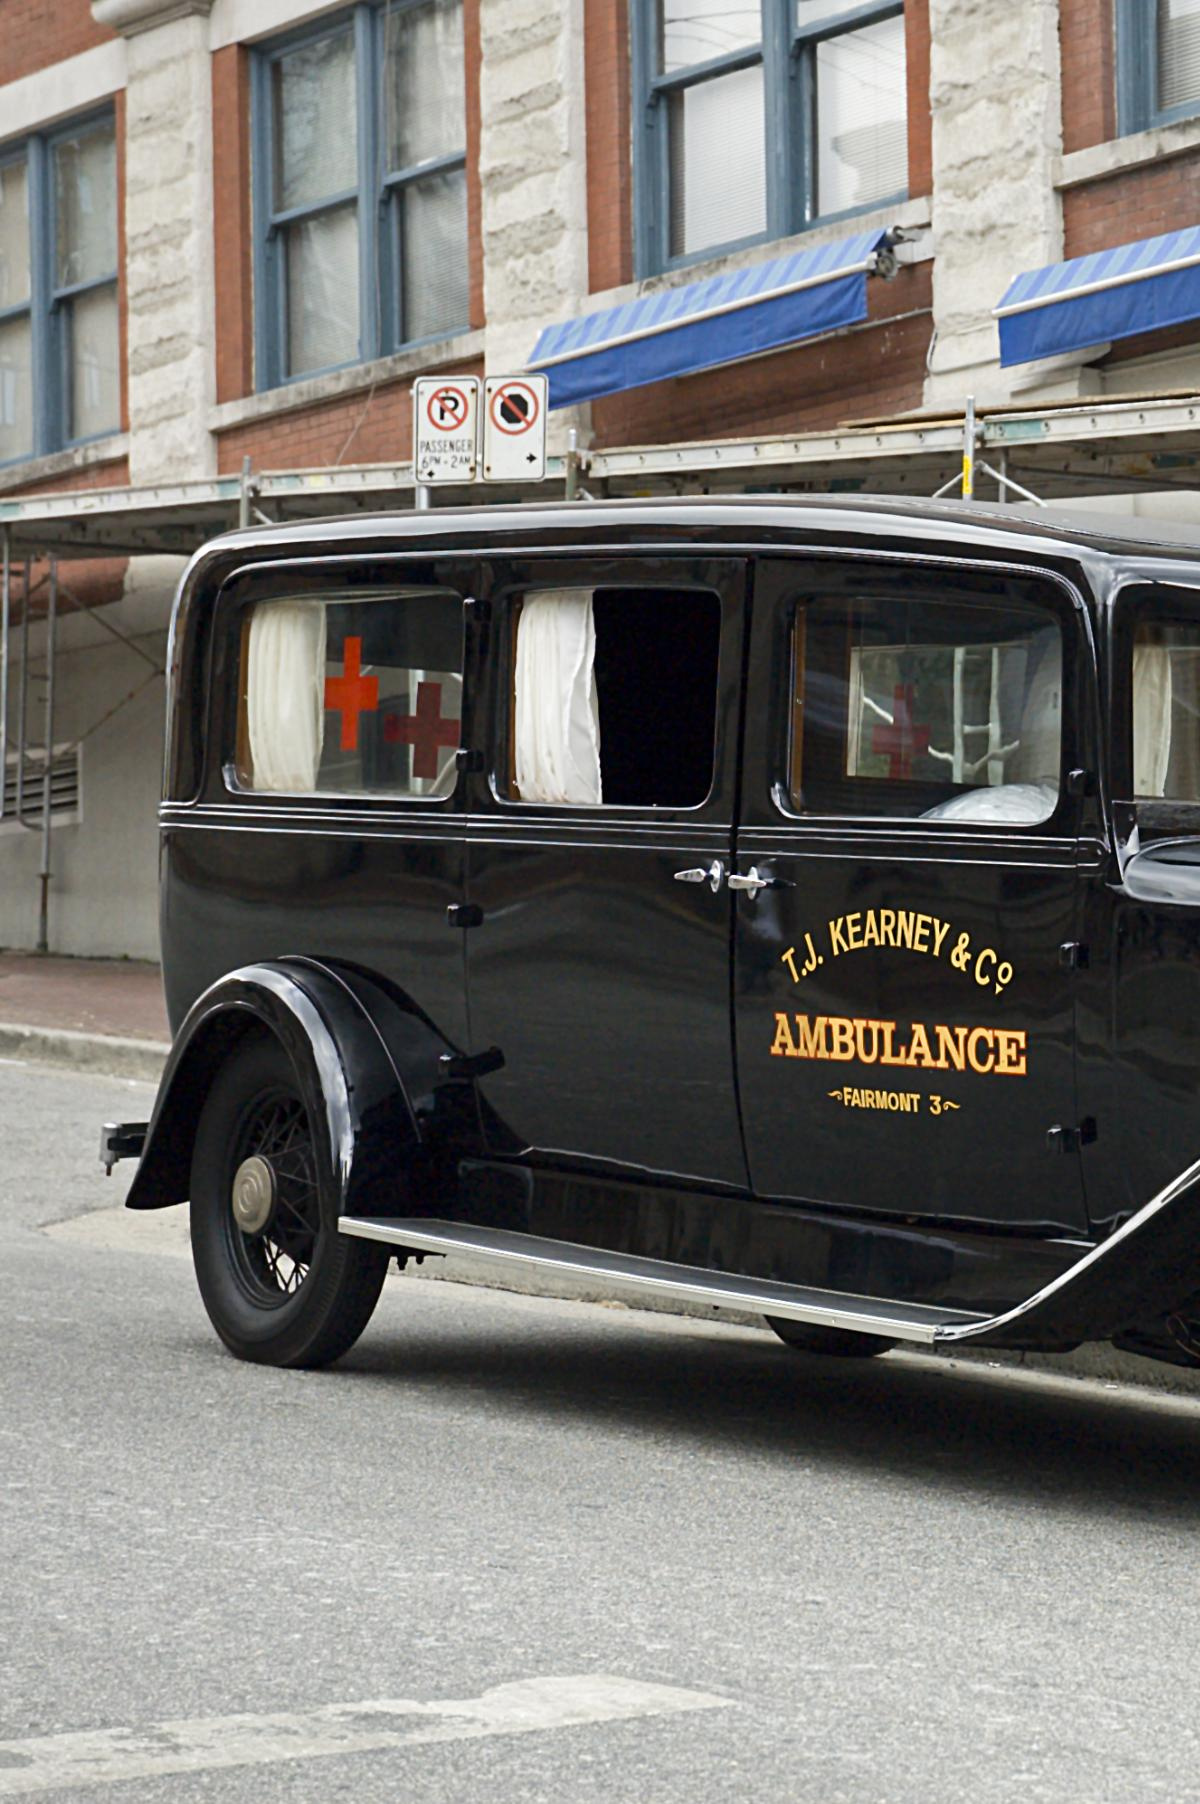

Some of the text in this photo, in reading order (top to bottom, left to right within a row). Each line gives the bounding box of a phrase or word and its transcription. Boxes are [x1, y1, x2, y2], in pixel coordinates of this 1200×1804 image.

[420, 440, 473, 453] PASSENGER
[422, 456, 442, 469] 6PM
[450, 455, 471, 468] 2AM
[829, 909, 950, 956] KEARNEY
[770, 1012, 1027, 1075] AMBULANCE
[843, 1086, 942, 1116] FAIRMONT 3
